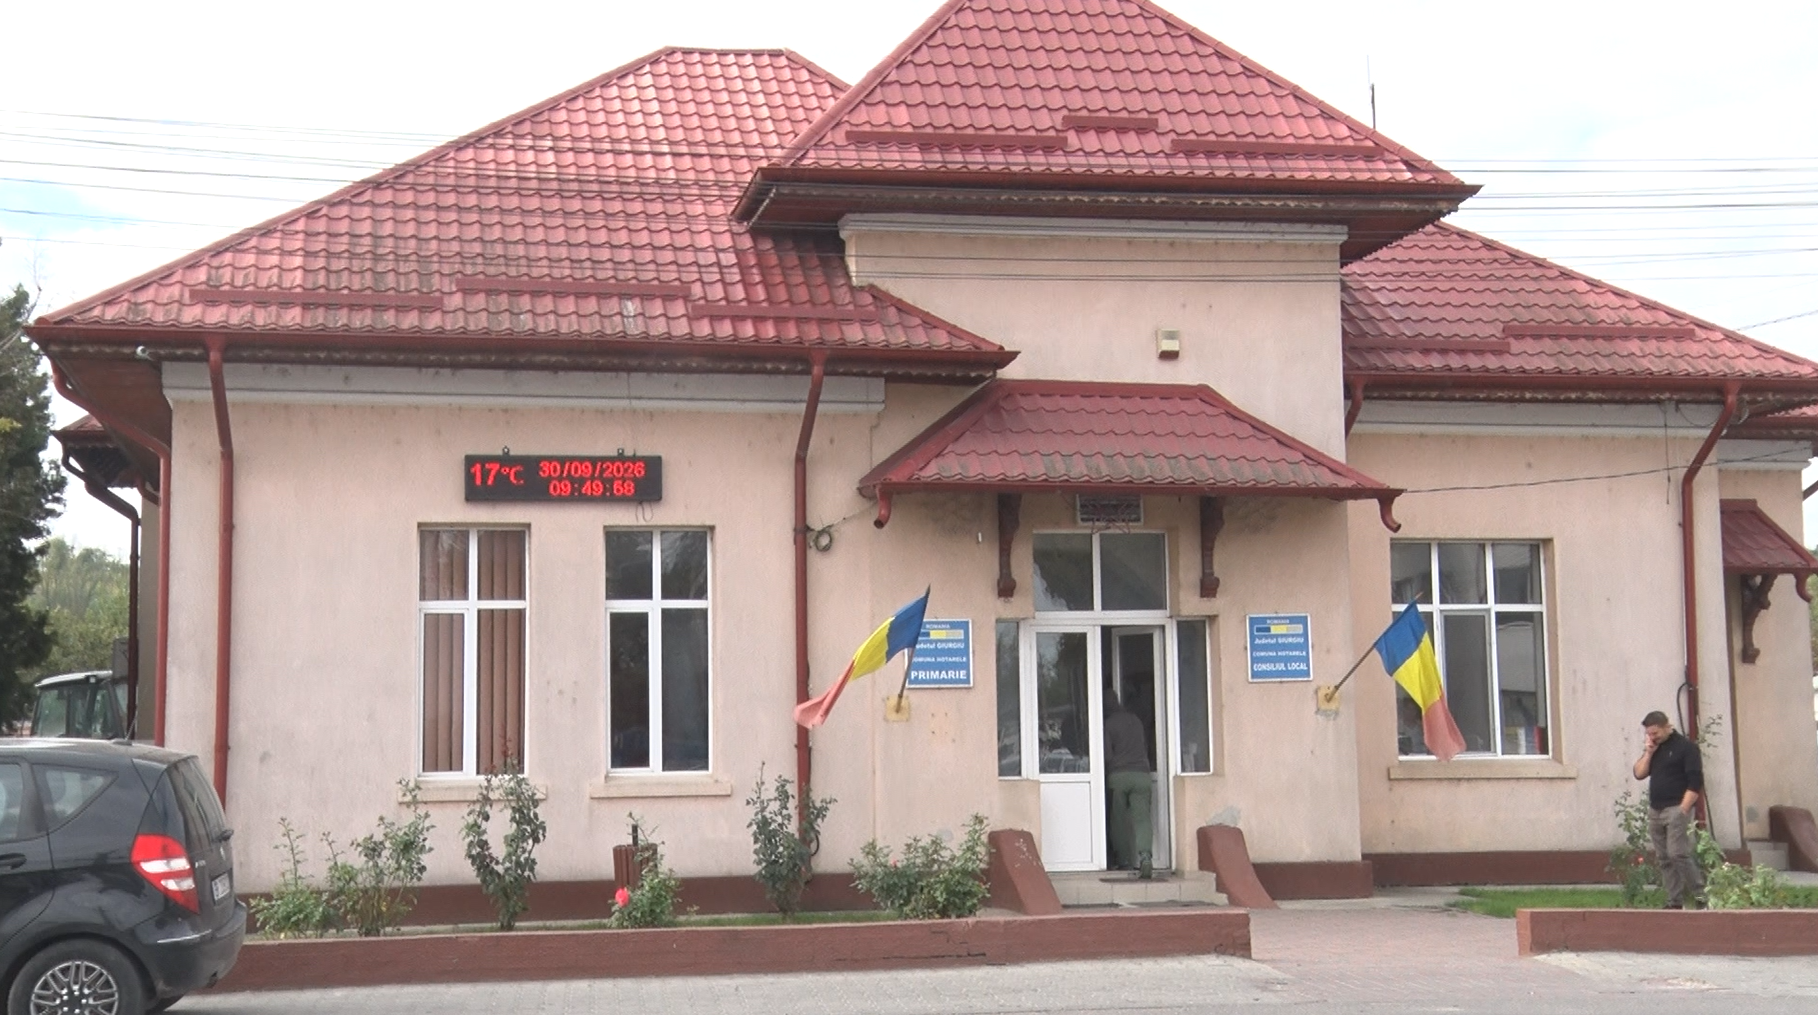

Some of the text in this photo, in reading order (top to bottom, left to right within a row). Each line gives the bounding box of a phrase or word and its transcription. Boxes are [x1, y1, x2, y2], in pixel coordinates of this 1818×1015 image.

[539, 461, 646, 478] 30/09/2026
[1253, 662, 1308, 671] CONSILIUL LOCAL
[911, 670, 967, 680] PRIMARIE
